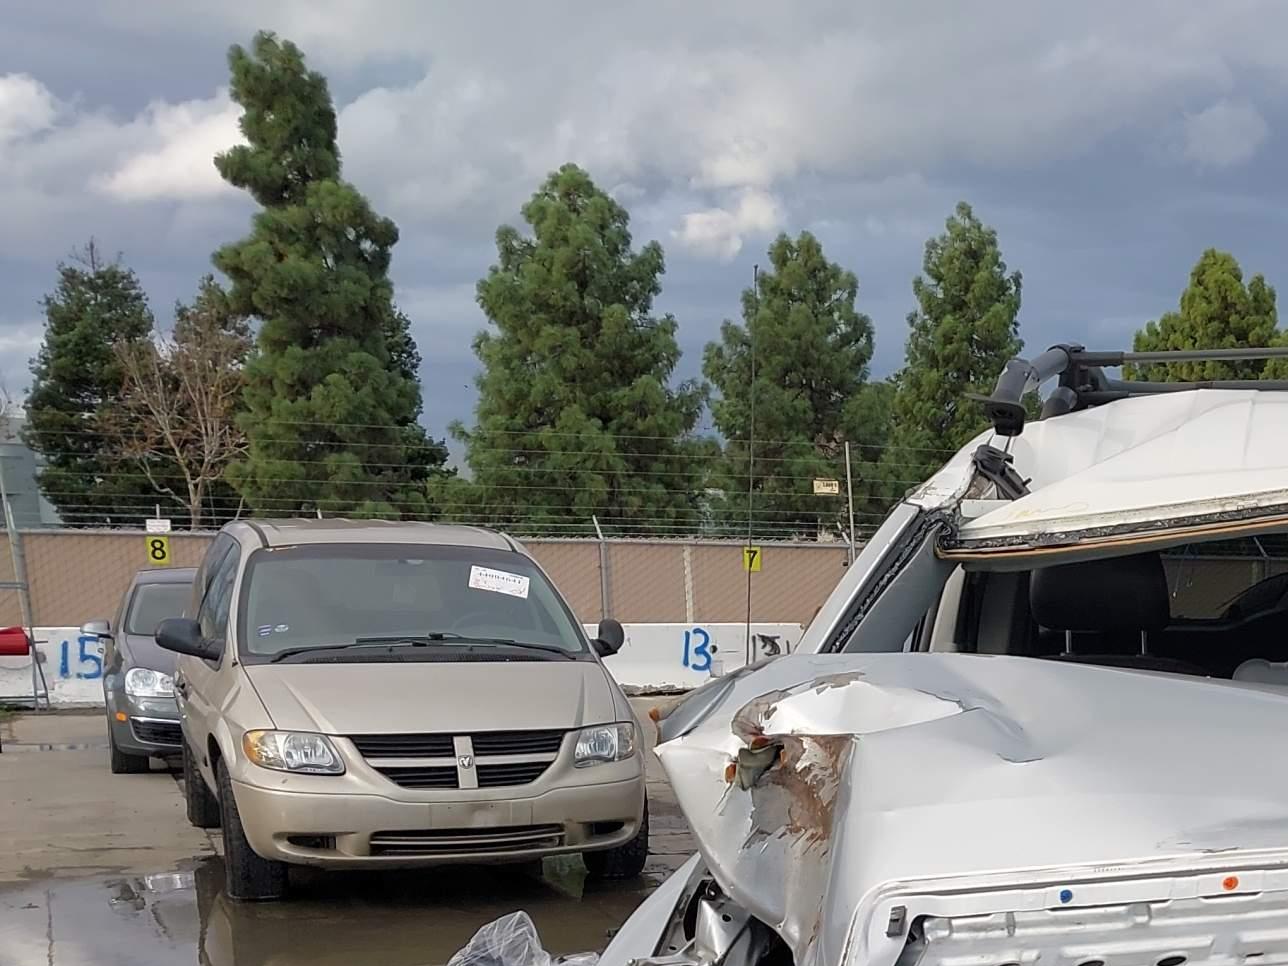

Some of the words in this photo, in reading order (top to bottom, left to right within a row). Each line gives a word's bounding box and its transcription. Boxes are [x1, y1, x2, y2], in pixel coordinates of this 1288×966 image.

[150, 538, 167, 561] 8
[745, 549, 758, 568] 7
[60, 635, 102, 679] 15
[683, 627, 712, 671] 13
